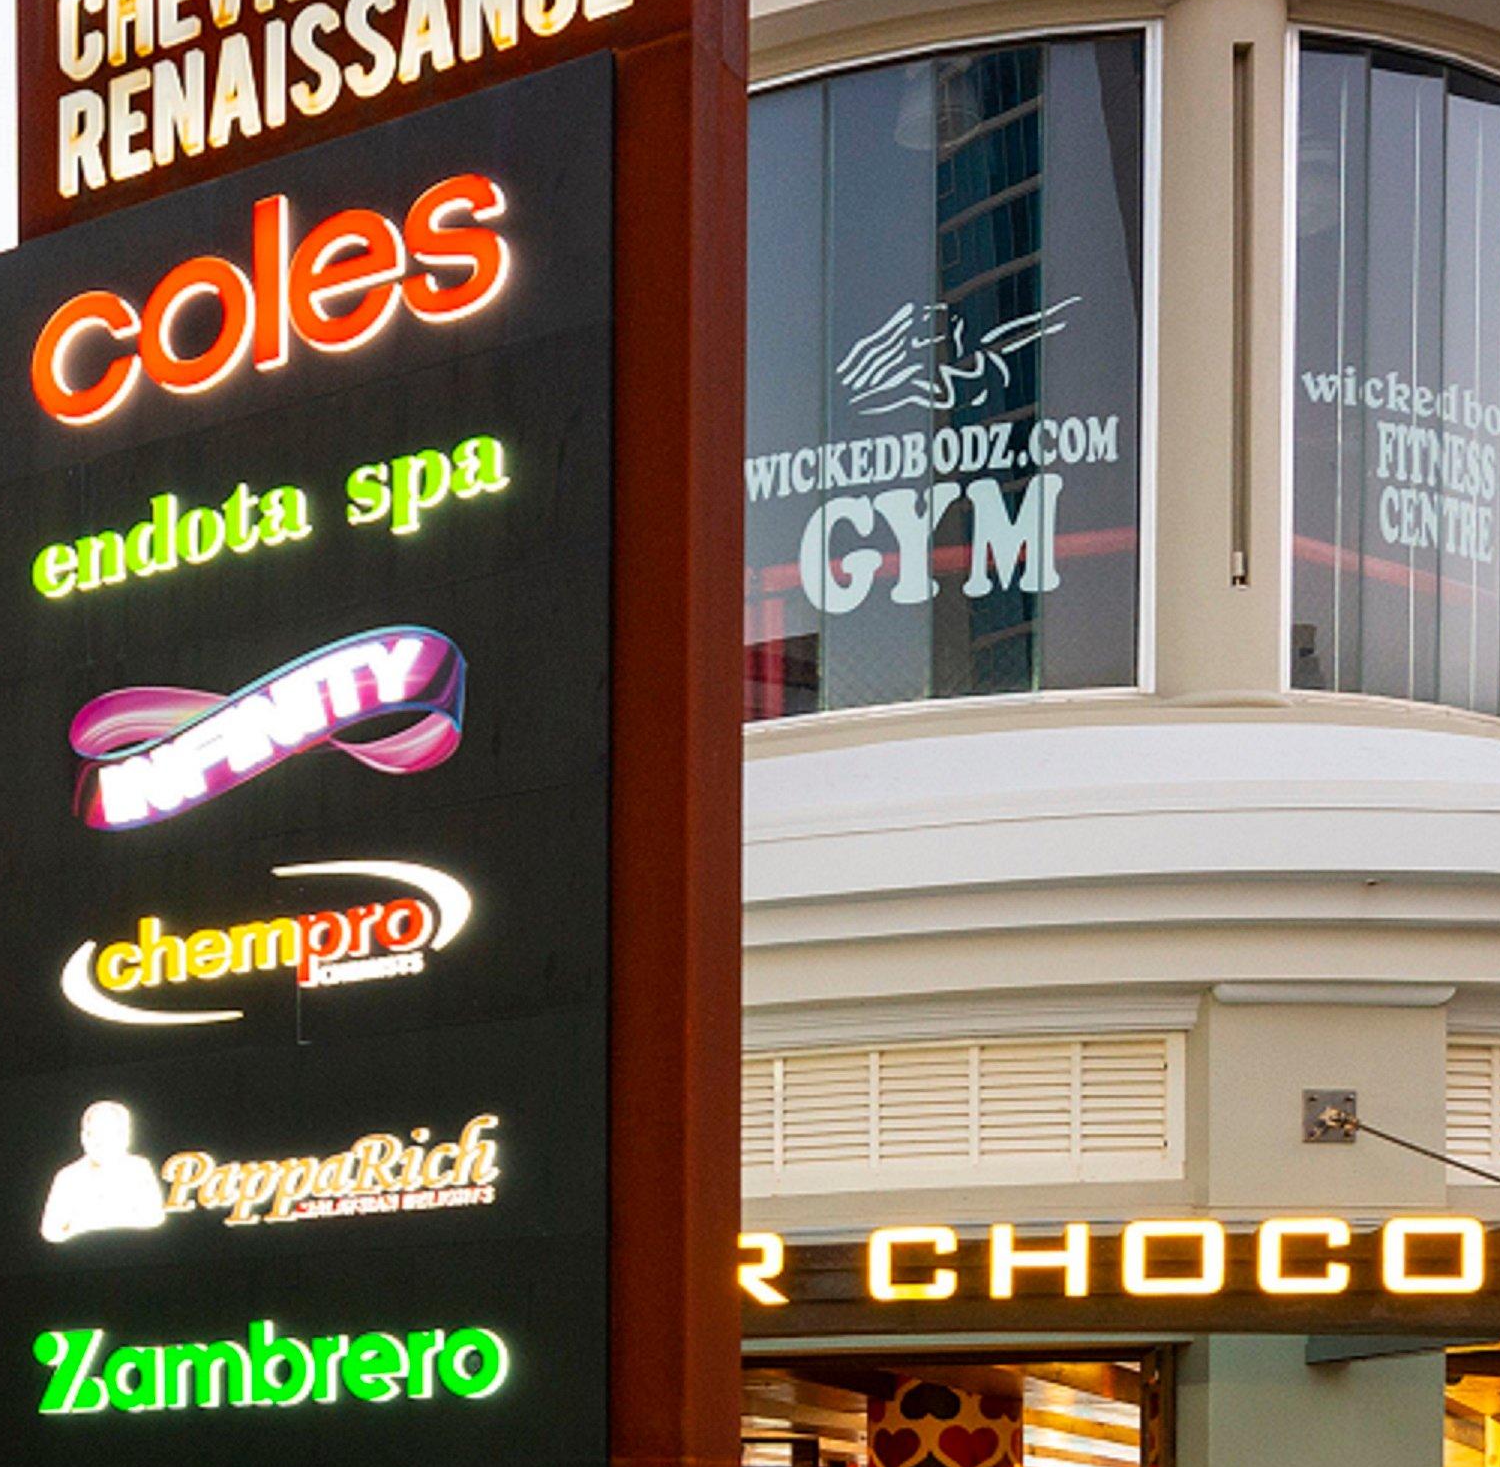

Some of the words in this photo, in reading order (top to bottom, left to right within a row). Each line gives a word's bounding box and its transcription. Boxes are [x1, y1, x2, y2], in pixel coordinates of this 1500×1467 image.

[31, 172, 510, 427] coles
[745, 416, 1120, 503] WICKEDBODZ.COM
[1376, 420, 1496, 501] FITNESS
[32, 482, 313, 599] endota
[346, 435, 511, 536] spa
[800, 473, 1063, 615] GYM
[1379, 485, 1494, 564] CENTRE
[96, 897, 434, 993] chempro
[161, 1114, 501, 1228] PappaRich
[33, 1320, 508, 1415] Zambrero
